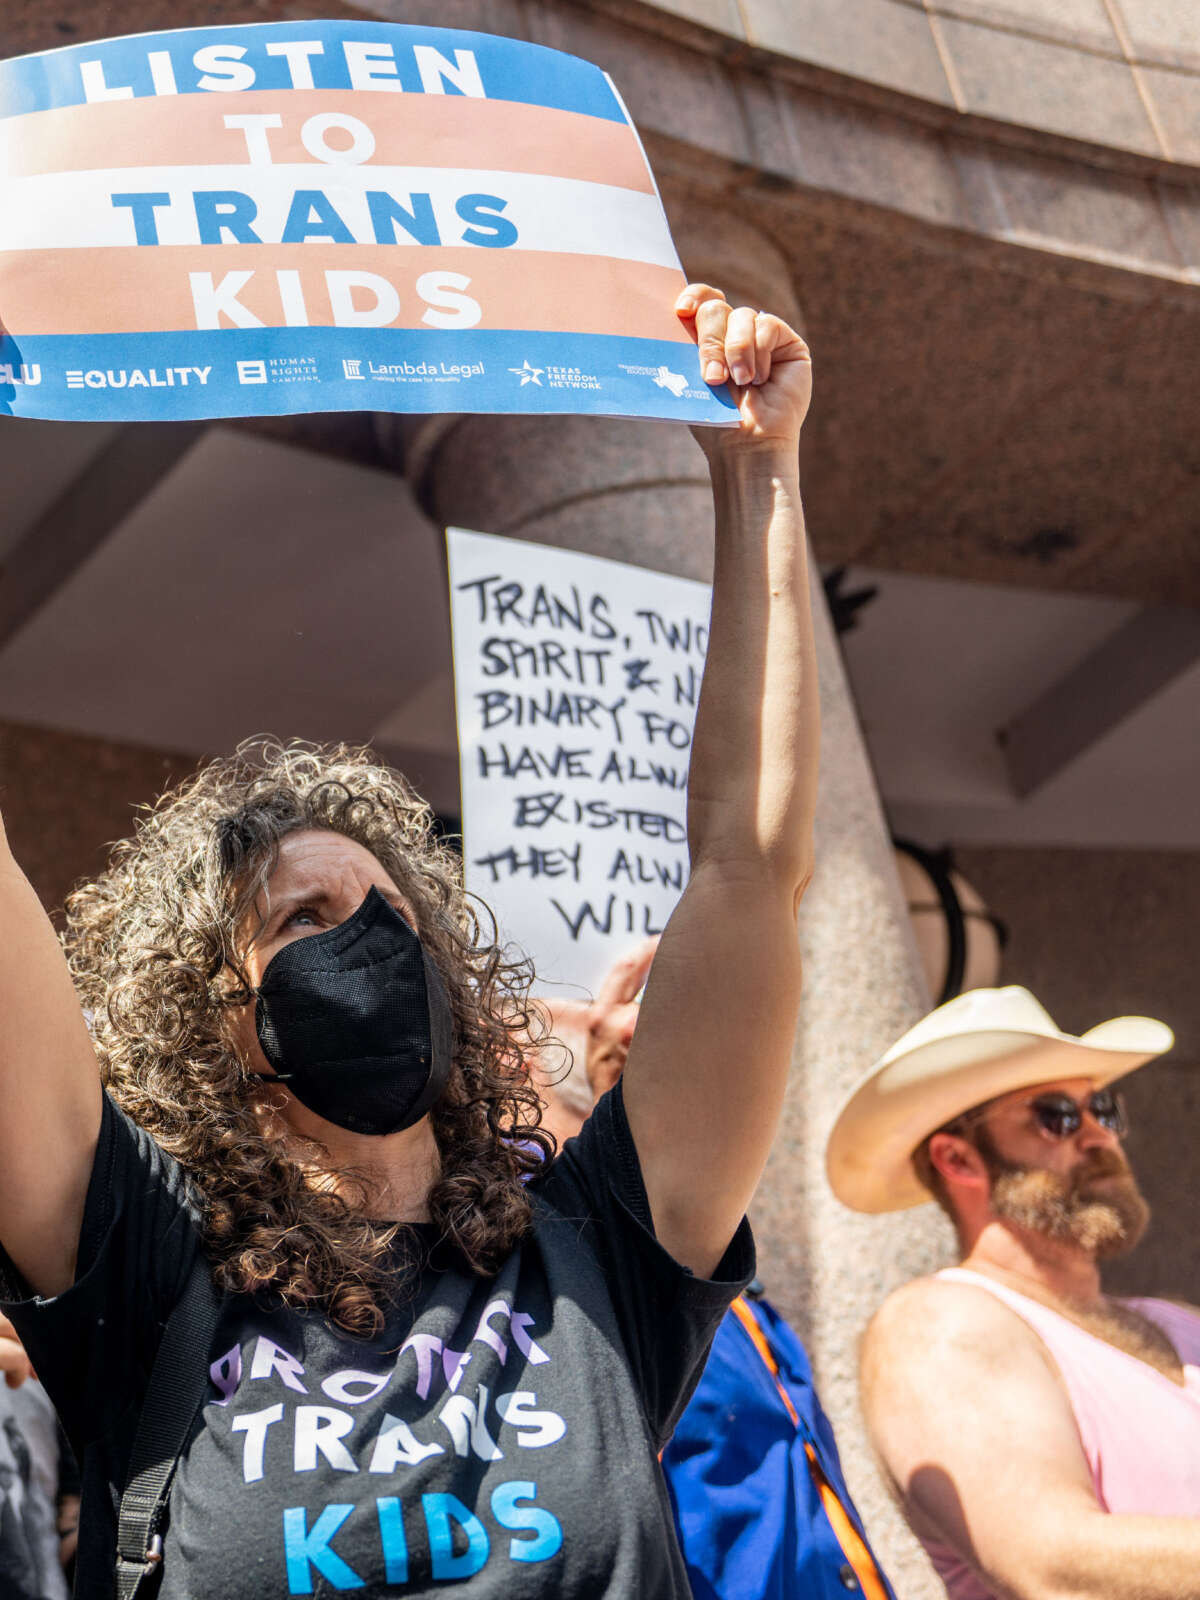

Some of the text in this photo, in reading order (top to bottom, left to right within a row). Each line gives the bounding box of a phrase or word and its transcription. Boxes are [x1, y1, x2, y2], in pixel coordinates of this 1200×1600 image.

[80, 41, 487, 104] LISTEN
[224, 112, 377, 166] TO
[111, 190, 519, 249] TRANS
[189, 270, 483, 330] KIDS
[66, 366, 212, 389] EQUALITY
[269, 357, 316, 367] HUMAN
[272, 366, 318, 376] RIGHTS
[368, 360, 485, 379] Lambda Legal
[545, 366, 582, 375] TEXAS
[547, 373, 598, 382] FREEDOM
[549, 380, 603, 390] NETWORK
[458, 576, 630, 650] TRANS,
[481, 637, 612, 688] SPIRIT
[476, 690, 626, 743] BINARY
[477, 743, 592, 780] HAVE
[514, 792, 687, 843] EXISTED
[474, 841, 582, 884] THEY
[231, 1384, 567, 1484] TRANS
[283, 1481, 563, 1595] KIDS
